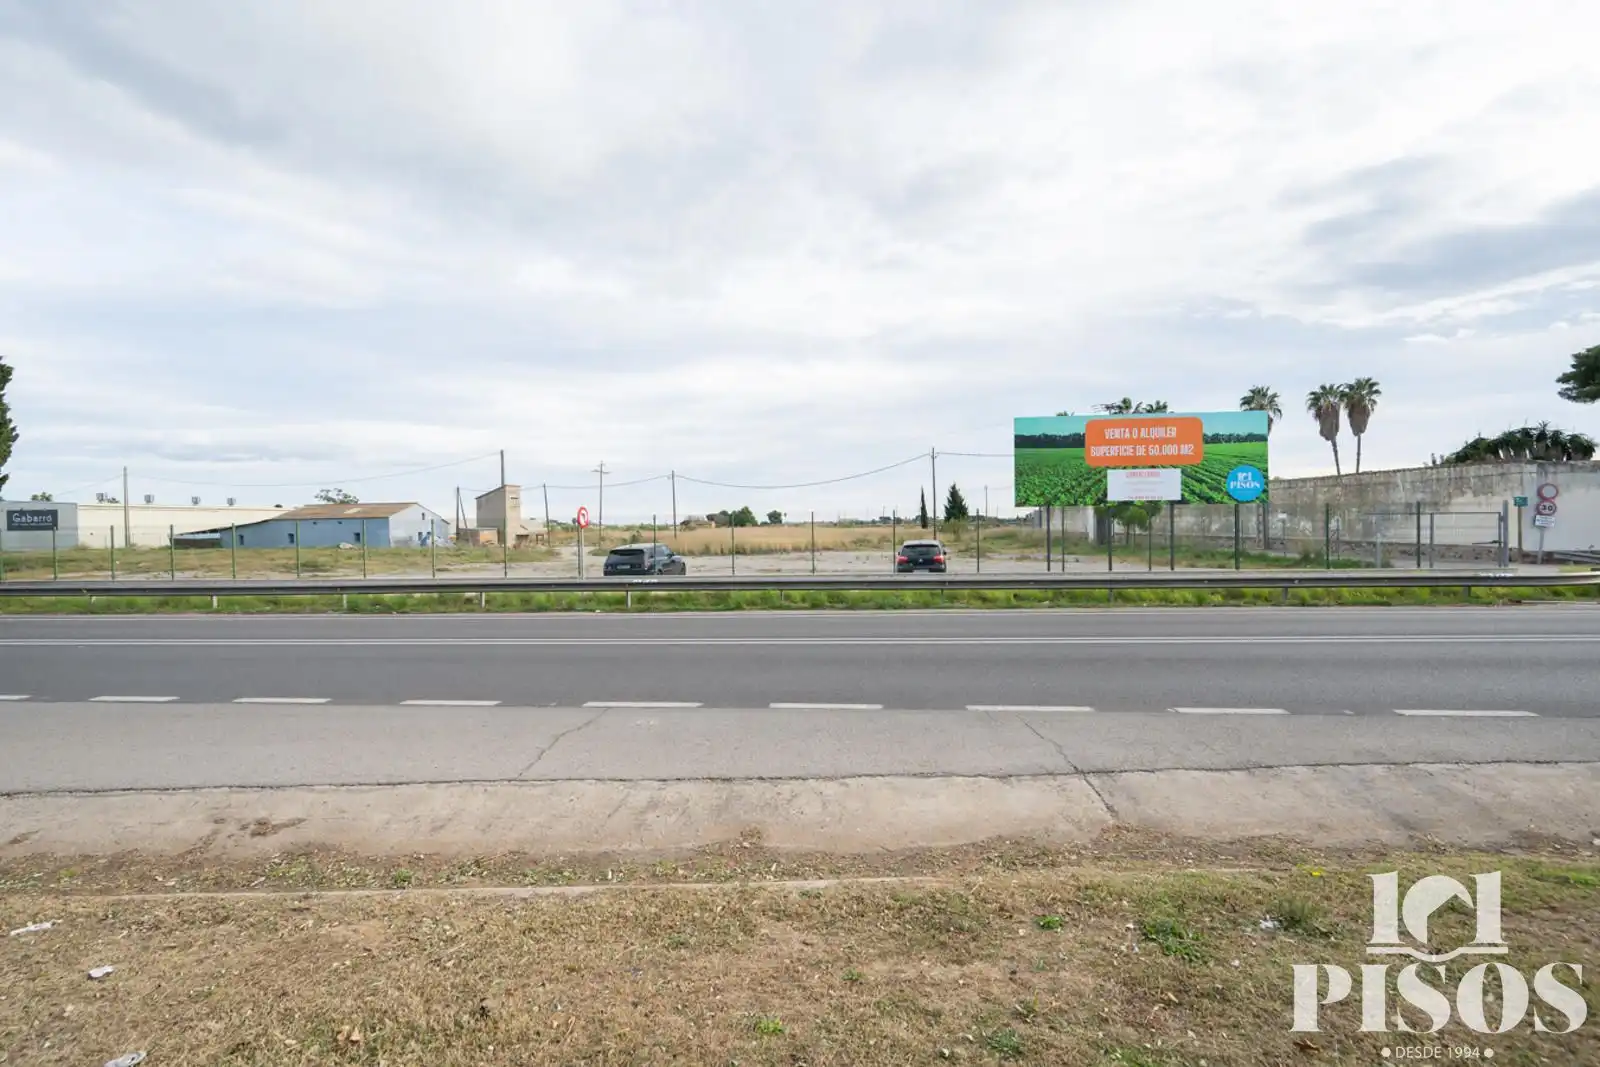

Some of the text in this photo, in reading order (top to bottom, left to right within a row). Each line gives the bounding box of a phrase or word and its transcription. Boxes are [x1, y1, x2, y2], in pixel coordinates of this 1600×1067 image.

[1104, 426, 1176, 439] VENTA O ALQUILER
[1090, 445, 1134, 456] SUPERFICIE
[1136, 445, 1147, 456] DE
[1180, 444, 1194, 455] M2
[1230, 481, 1260, 489] PISOS
[1540, 504, 1553, 512] 30
